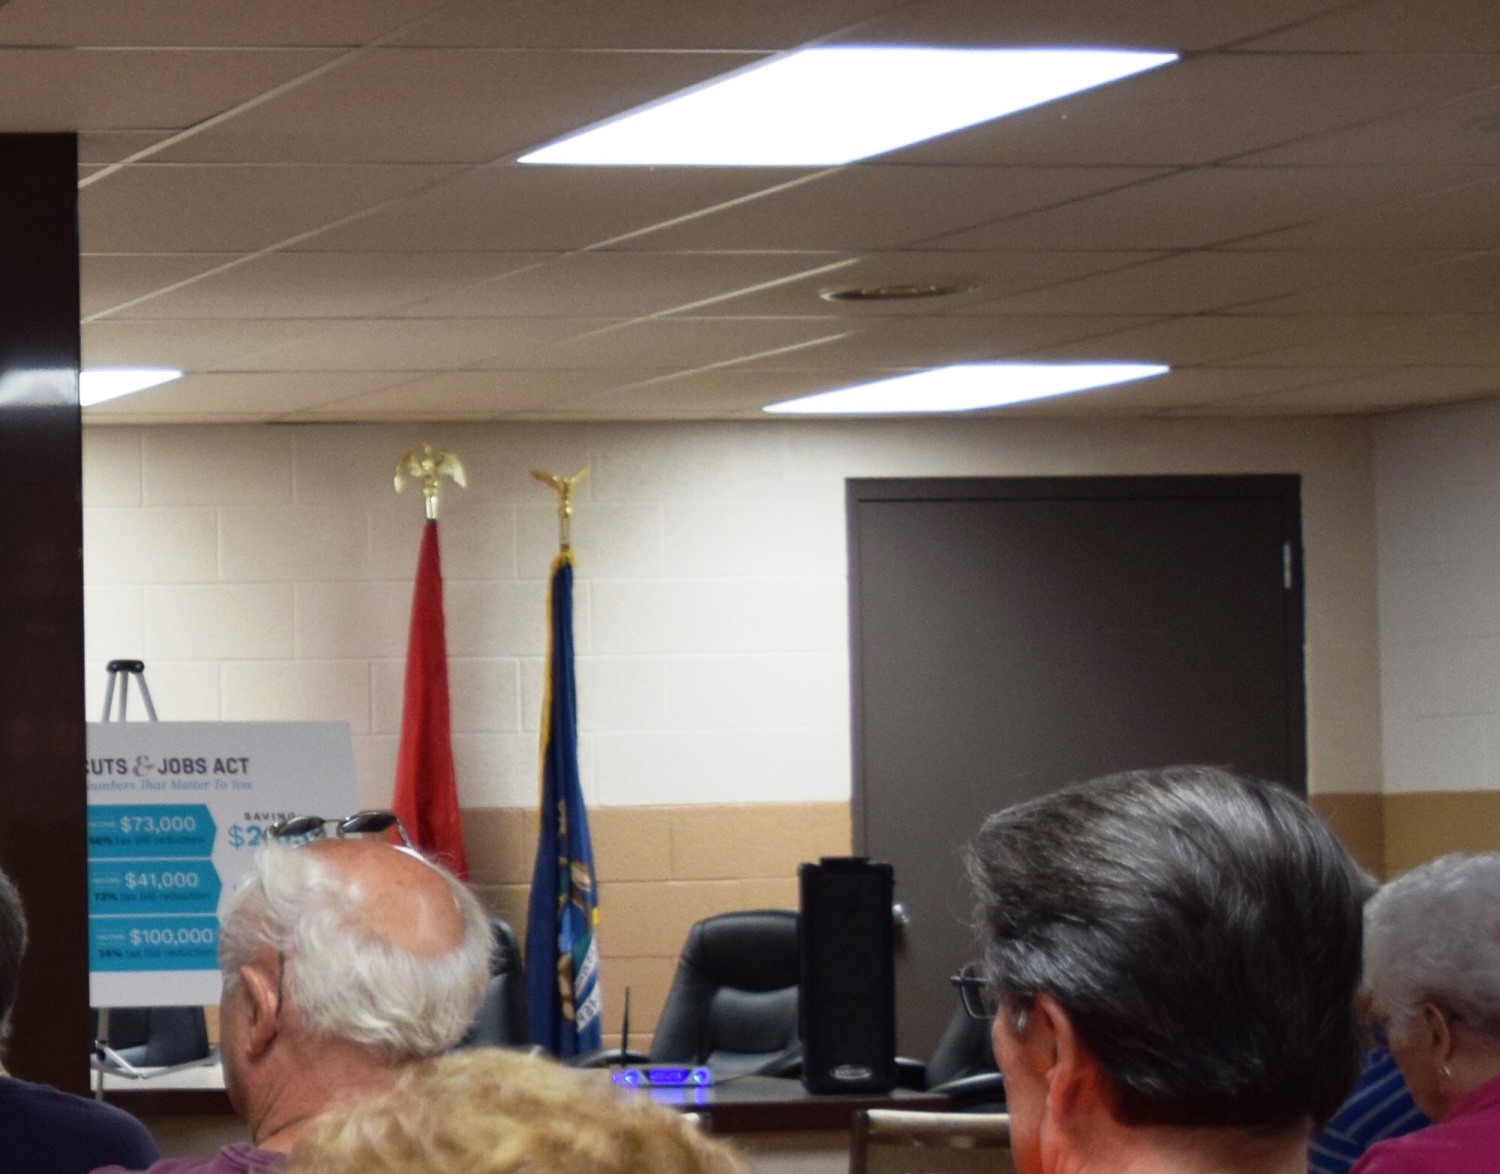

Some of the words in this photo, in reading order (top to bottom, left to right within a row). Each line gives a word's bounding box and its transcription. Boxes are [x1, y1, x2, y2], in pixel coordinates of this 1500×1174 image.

[157, 757, 207, 774] JOBS
[214, 757, 249, 774] ACT
[119, 815, 196, 833] $73,000
[124, 871, 198, 890] $41,000
[129, 927, 213, 947] $100,000
